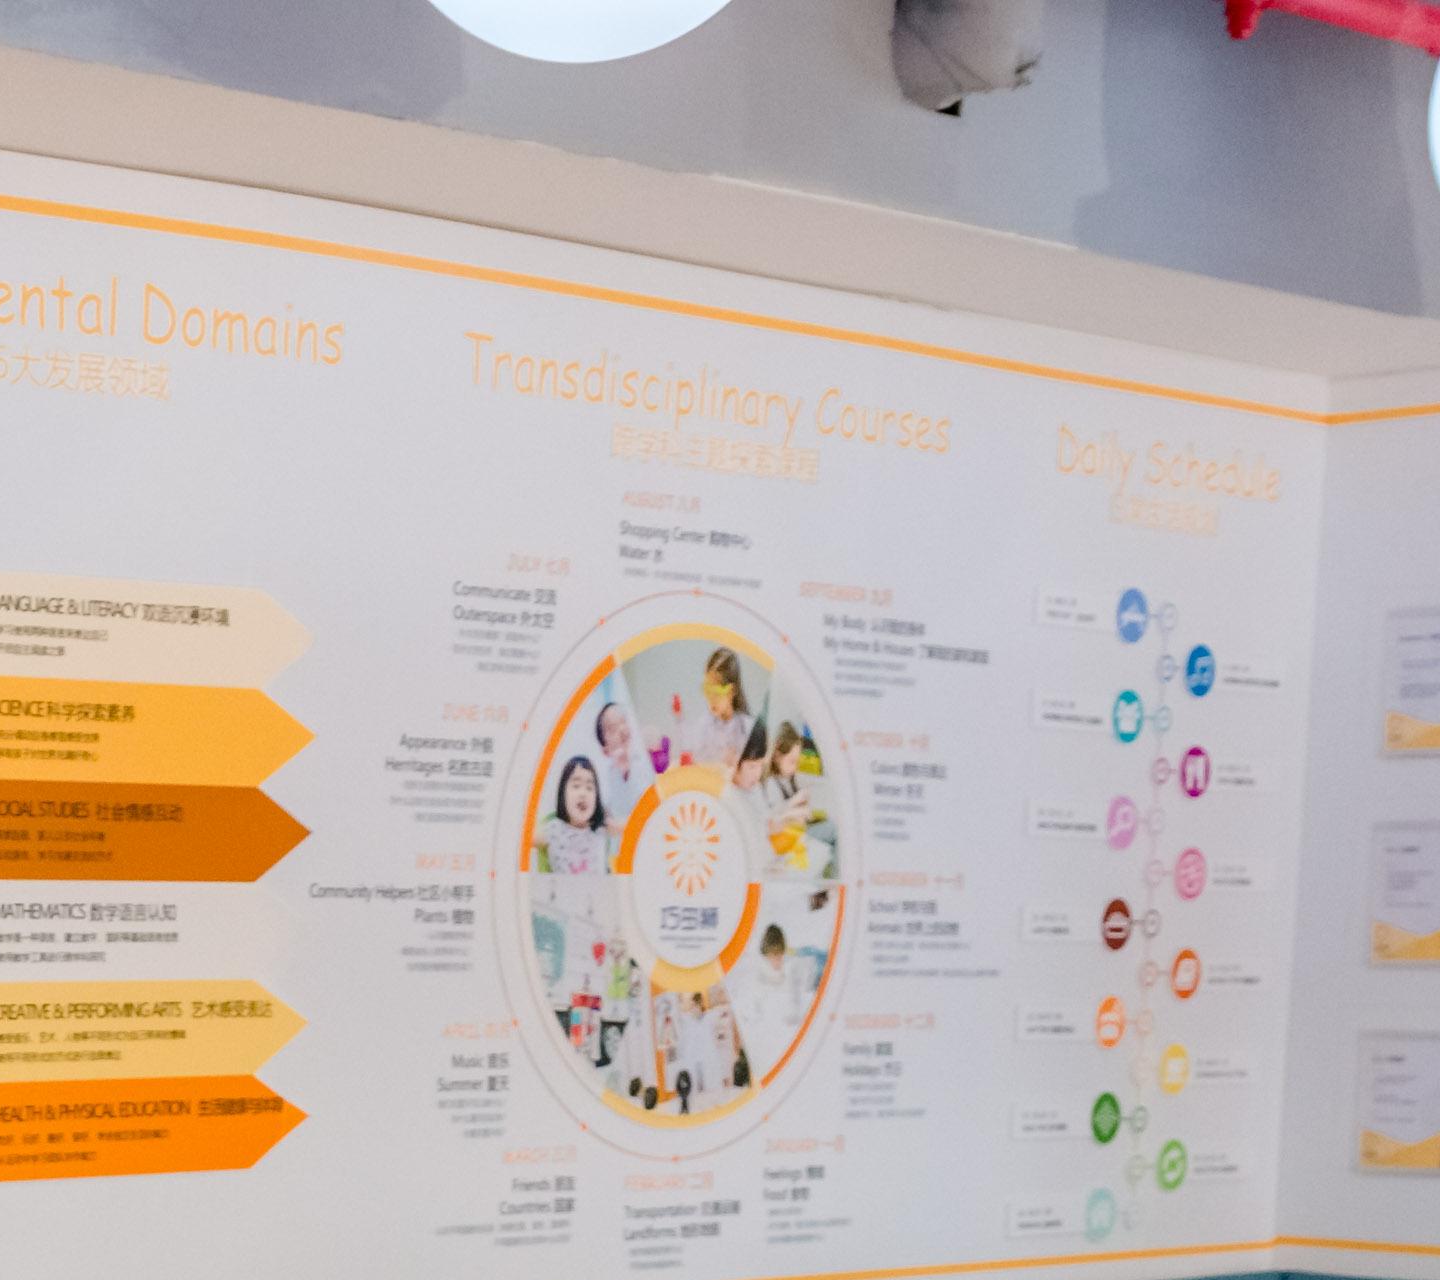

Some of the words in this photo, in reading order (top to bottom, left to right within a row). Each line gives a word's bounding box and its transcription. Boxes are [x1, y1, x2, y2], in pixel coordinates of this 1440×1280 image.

[142, 283, 345, 366] Domains
[463, 330, 804, 447] Transdisciplinary
[817, 388, 953, 454] Courses
[1056, 420, 1136, 497] Daily
[1145, 440, 1280, 503] Schedule
[80, 598, 139, 619] LITERACY
[309, 883, 371, 903] Community
[66, 1001, 149, 1020] PERFORMING
[150, 1000, 183, 1018] ARTS
[58, 1101, 117, 1122] PHYSICAL
[119, 1099, 191, 1119] EDUCATION
